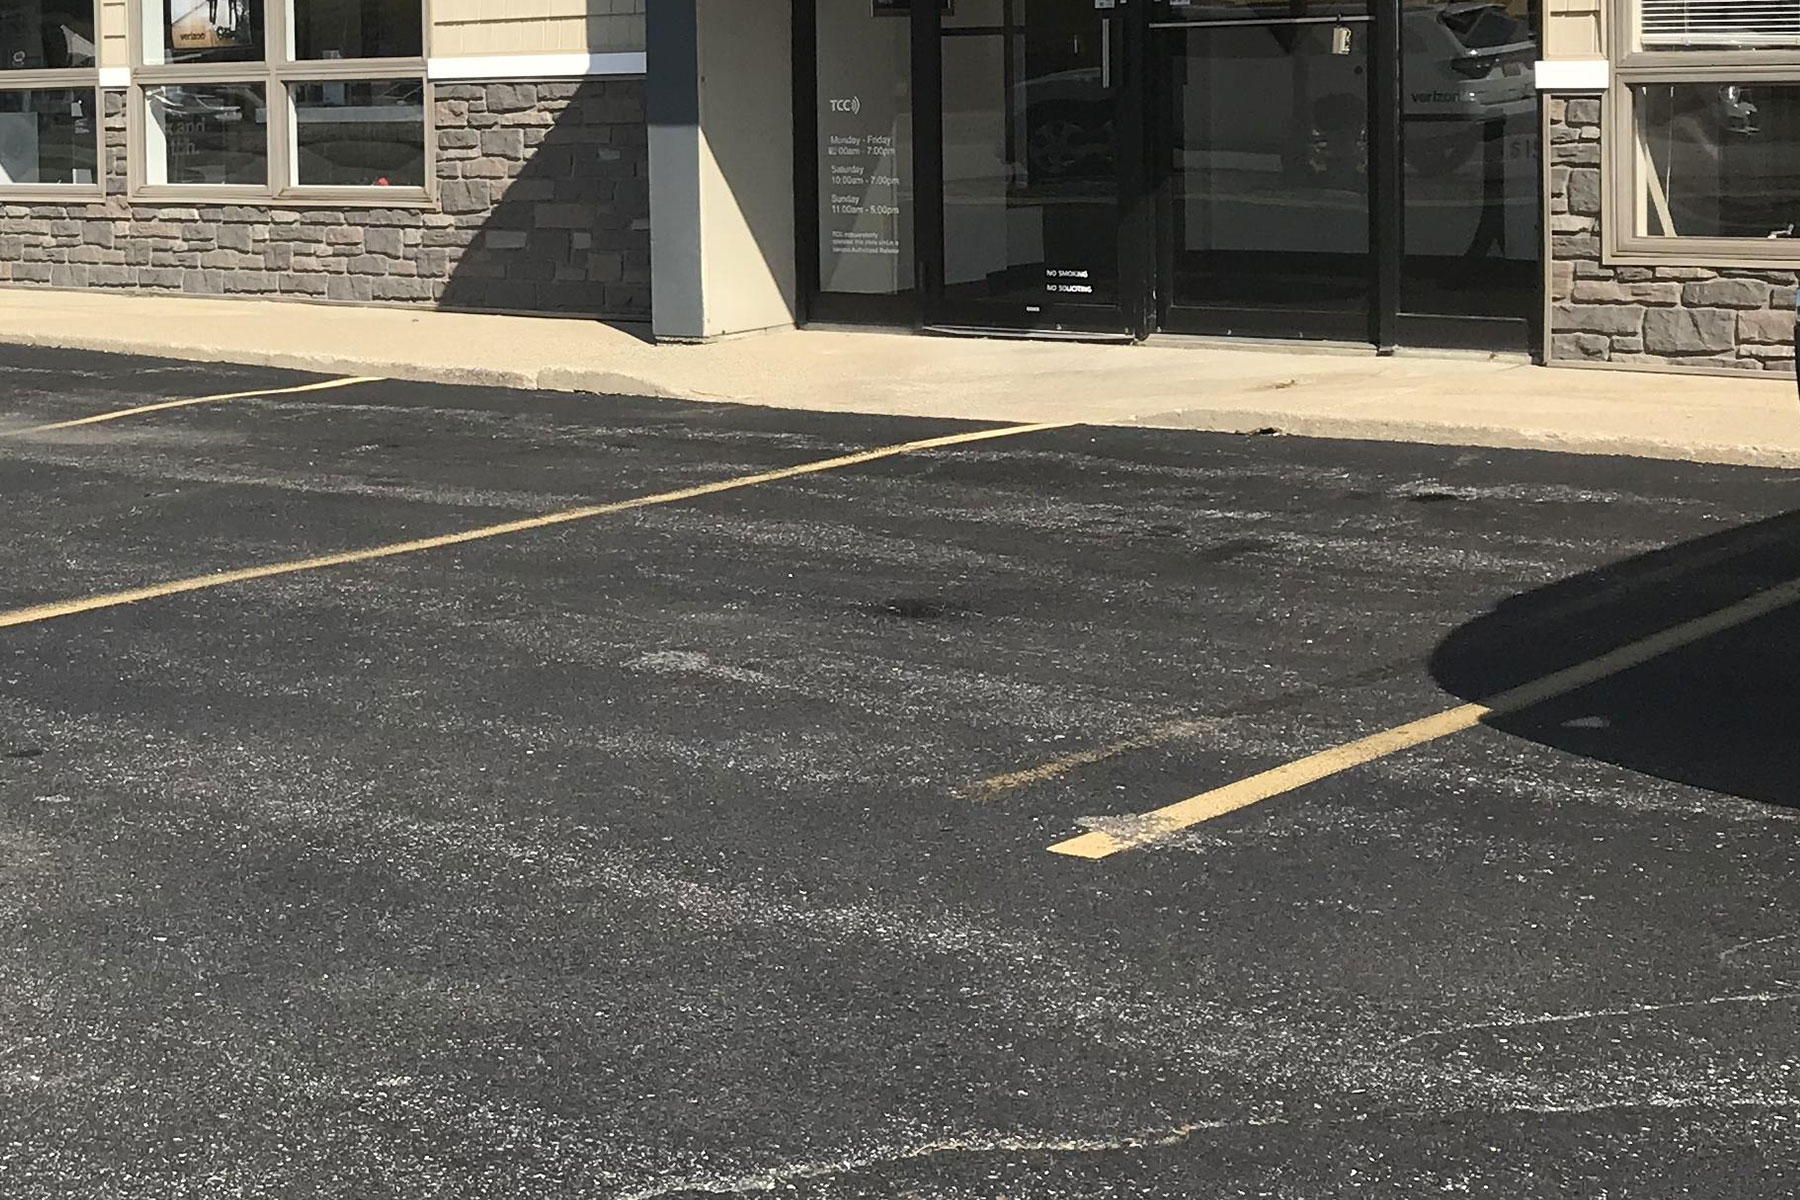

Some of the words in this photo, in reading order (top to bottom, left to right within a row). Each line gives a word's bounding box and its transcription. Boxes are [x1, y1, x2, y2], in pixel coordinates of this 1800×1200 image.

[830, 99, 852, 112] TCC
[830, 135, 861, 146] Monday
[867, 135, 891, 146] Friday
[831, 194, 860, 205] Sunday
